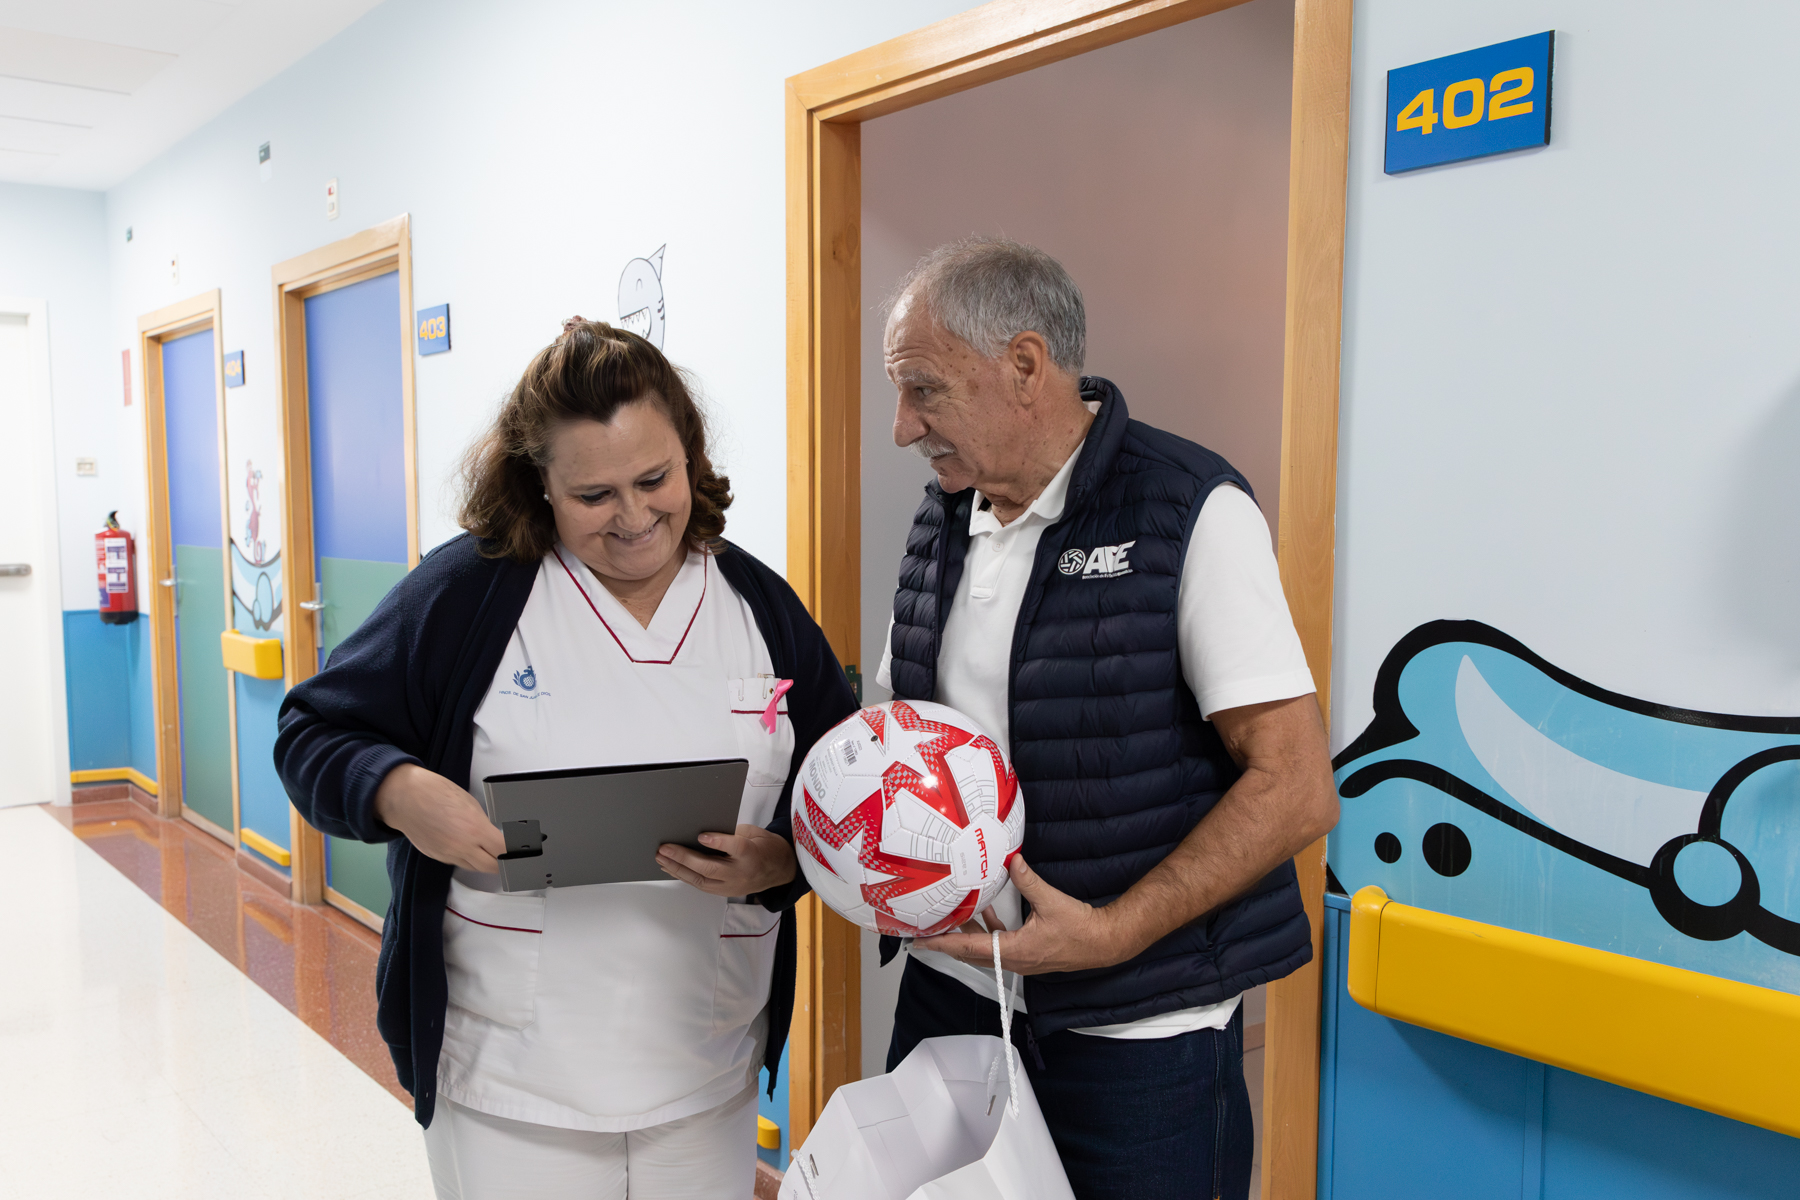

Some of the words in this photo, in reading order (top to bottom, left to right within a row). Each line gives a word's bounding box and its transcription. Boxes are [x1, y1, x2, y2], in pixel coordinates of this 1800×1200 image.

[1396, 66, 1535, 135] 402
[419, 315, 446, 341] 403
[809, 758, 826, 800] MONDO
[974, 827, 989, 881] MATCH
